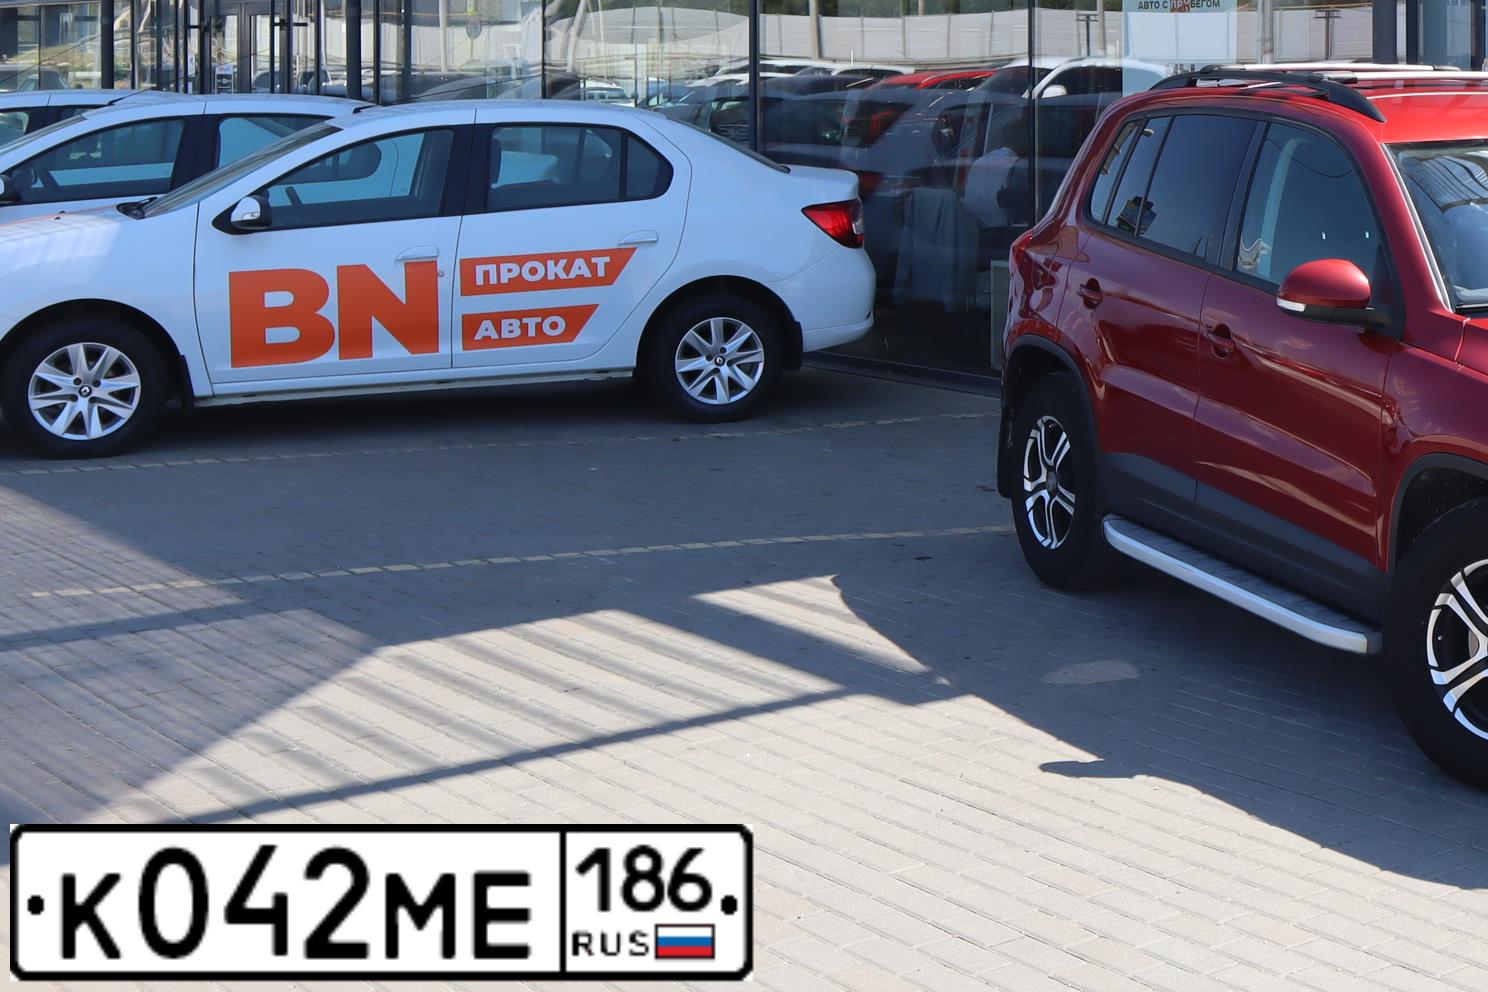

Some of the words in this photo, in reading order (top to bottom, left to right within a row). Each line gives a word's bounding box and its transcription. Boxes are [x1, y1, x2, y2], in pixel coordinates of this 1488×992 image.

[1137, 0, 1160, 10] АВТО
[474, 256, 611, 286] ПРОКАТ
[229, 259, 440, 368] BN
[474, 315, 567, 341] АВТО
